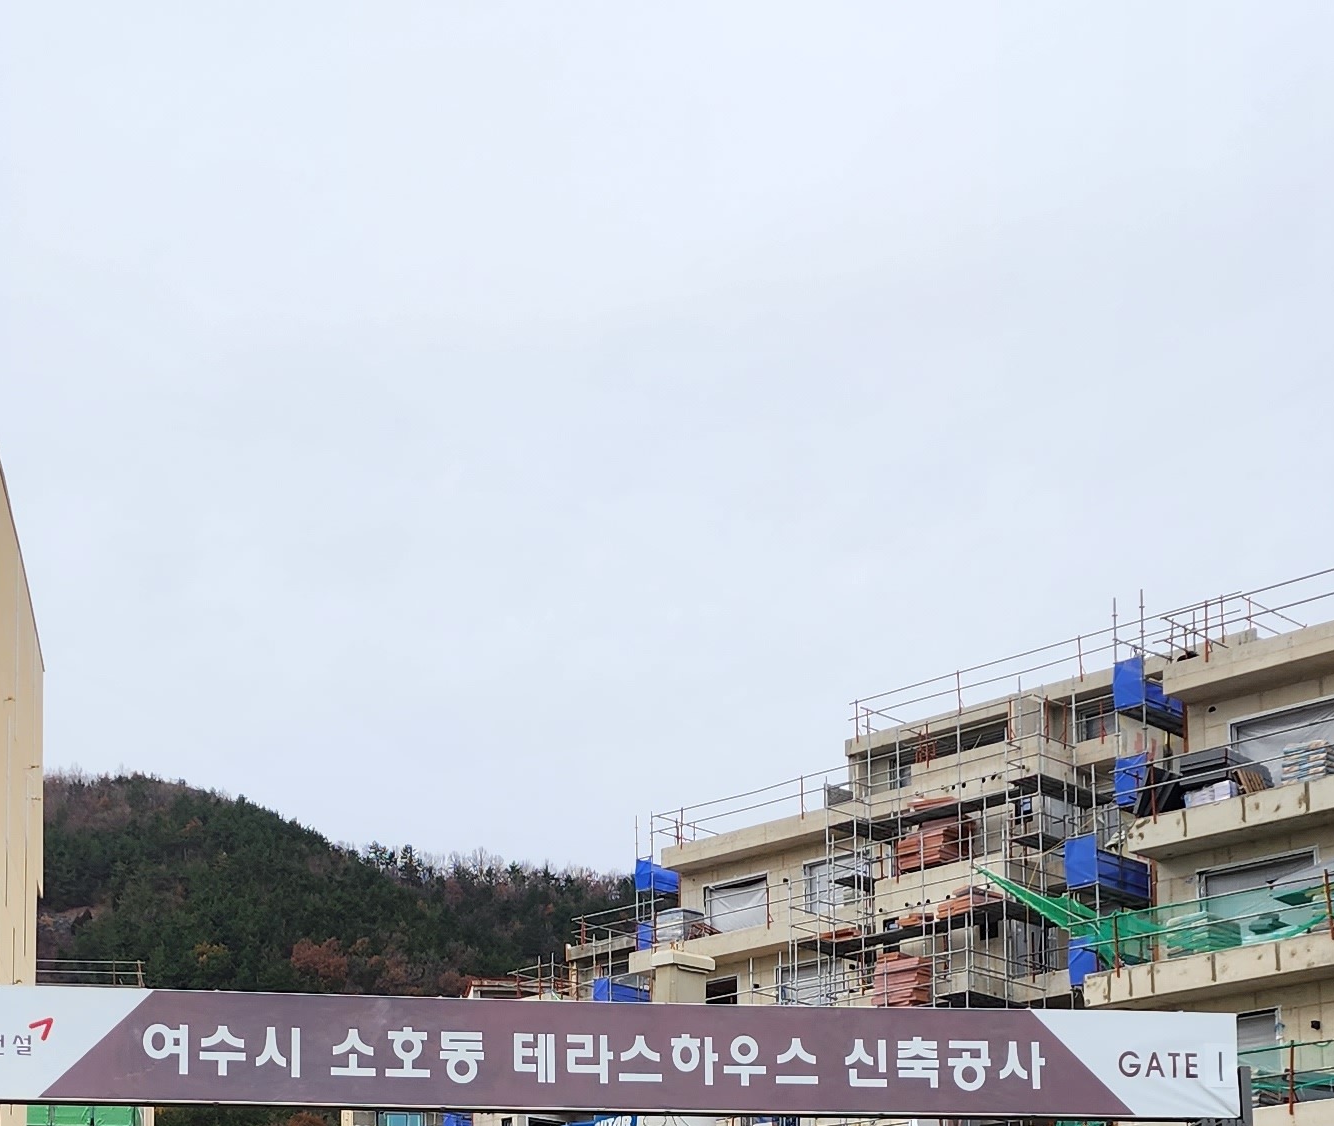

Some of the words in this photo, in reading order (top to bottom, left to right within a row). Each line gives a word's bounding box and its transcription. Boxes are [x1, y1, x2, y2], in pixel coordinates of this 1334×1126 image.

[142, 1020, 302, 1079] 여수시
[330, 1026, 486, 1083] 소호동
[512, 1033, 819, 1086] 테라스하우스
[844, 1037, 1046, 1092] 신축공사
[1118, 1050, 1199, 1079] GATE
